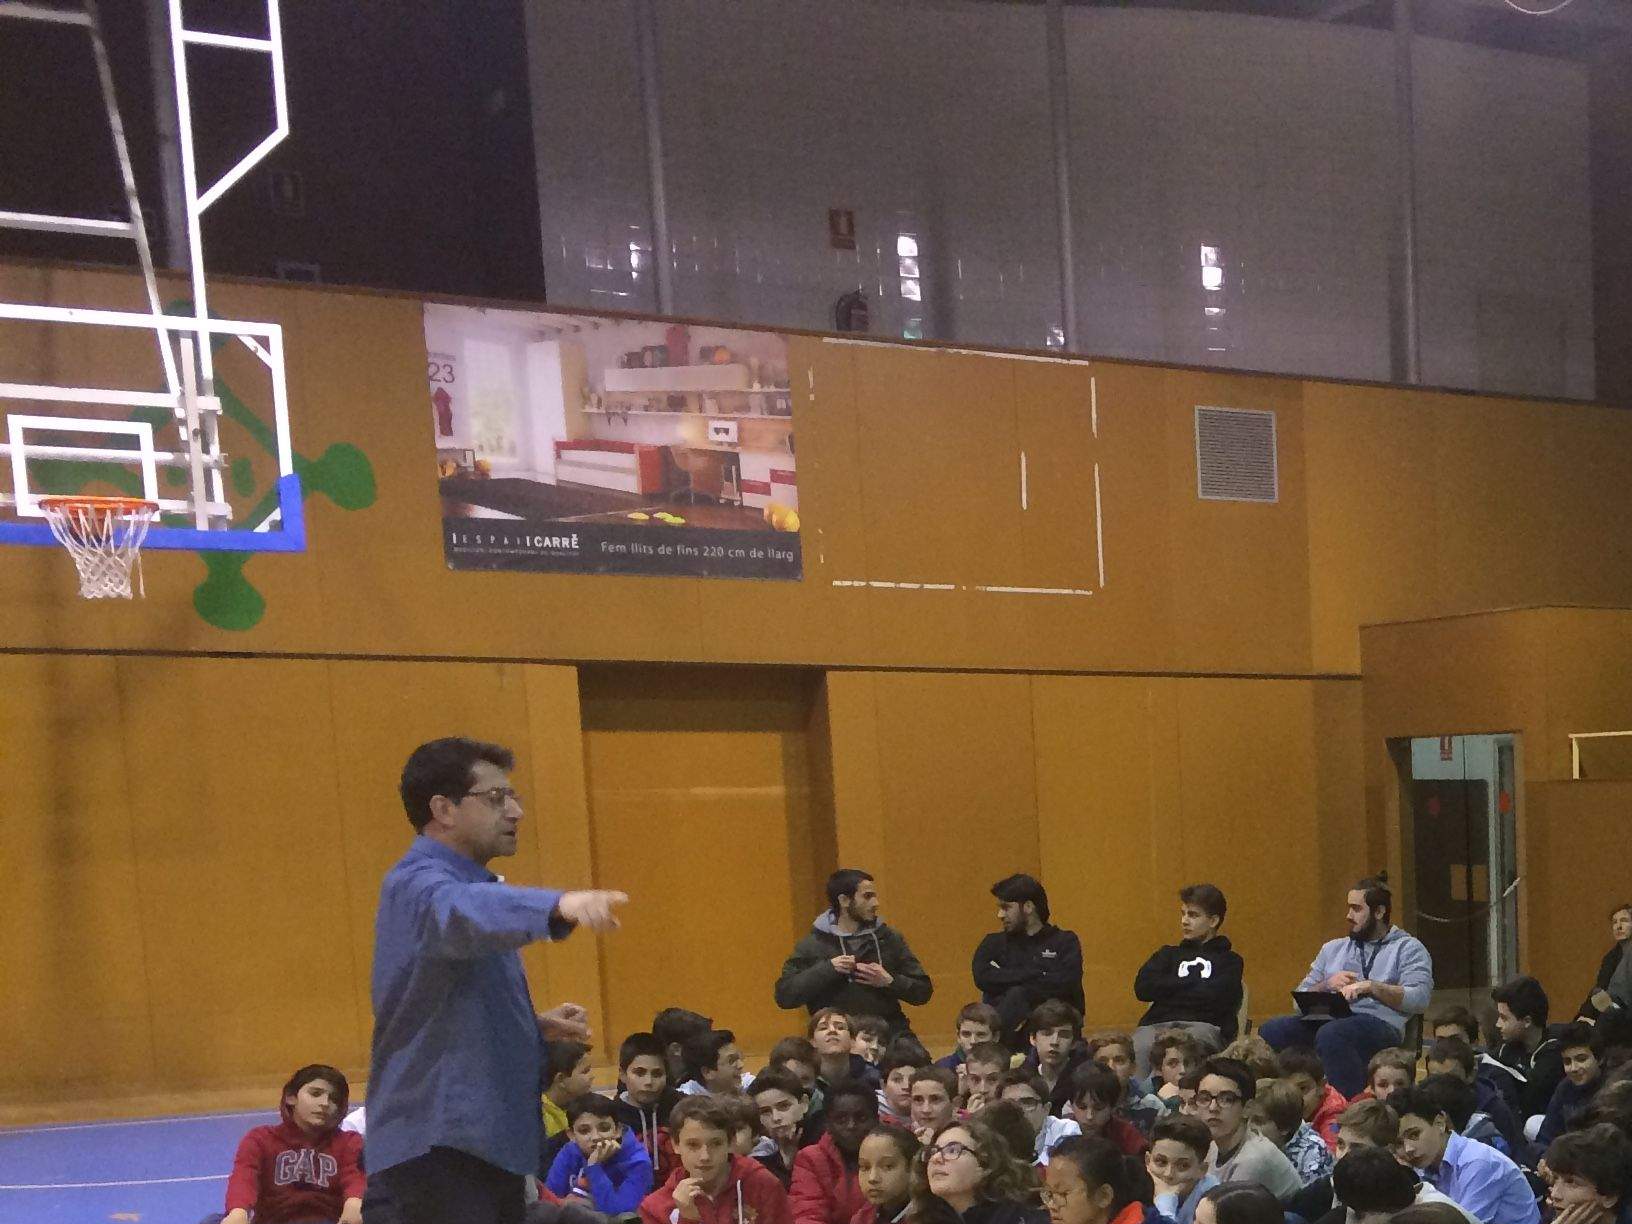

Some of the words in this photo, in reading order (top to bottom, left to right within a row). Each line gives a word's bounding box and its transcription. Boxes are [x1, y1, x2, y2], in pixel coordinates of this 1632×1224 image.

[428, 362, 455, 383] 23
[600, 541, 627, 553] Fem
[657, 544, 672, 555] de
[728, 549, 745, 557] cm
[749, 548, 764, 558] de
[275, 1149, 338, 1188] GAP
